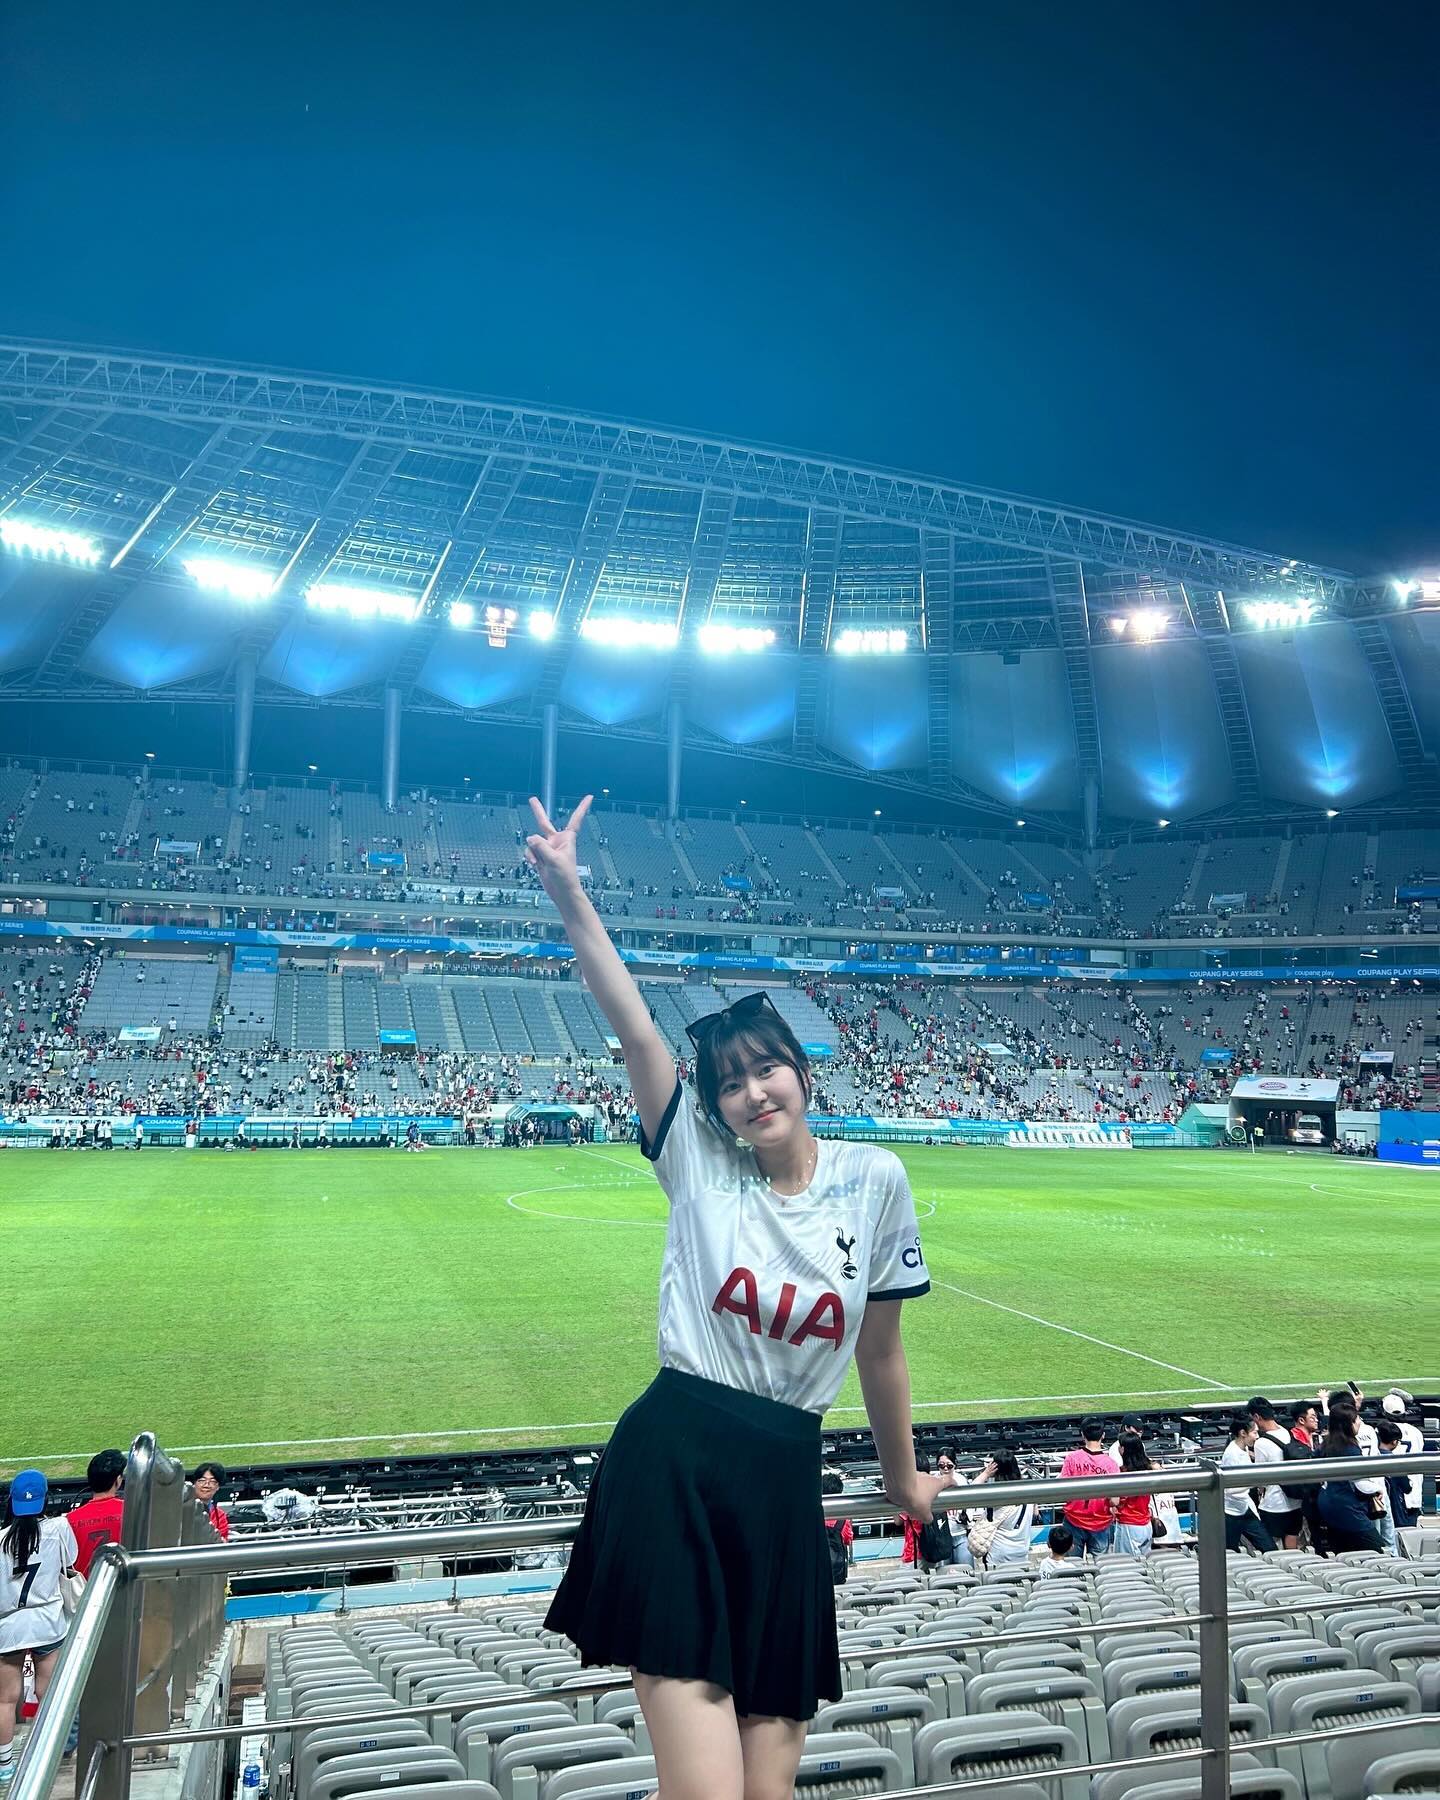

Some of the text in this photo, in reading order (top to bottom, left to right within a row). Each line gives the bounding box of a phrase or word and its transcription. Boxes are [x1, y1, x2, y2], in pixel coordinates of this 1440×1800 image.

[177, 929, 202, 937] COUPANG
[1321, 969, 1335, 977] play
[711, 1267, 846, 1352] AIA
[12, 1562, 42, 1609] 7
